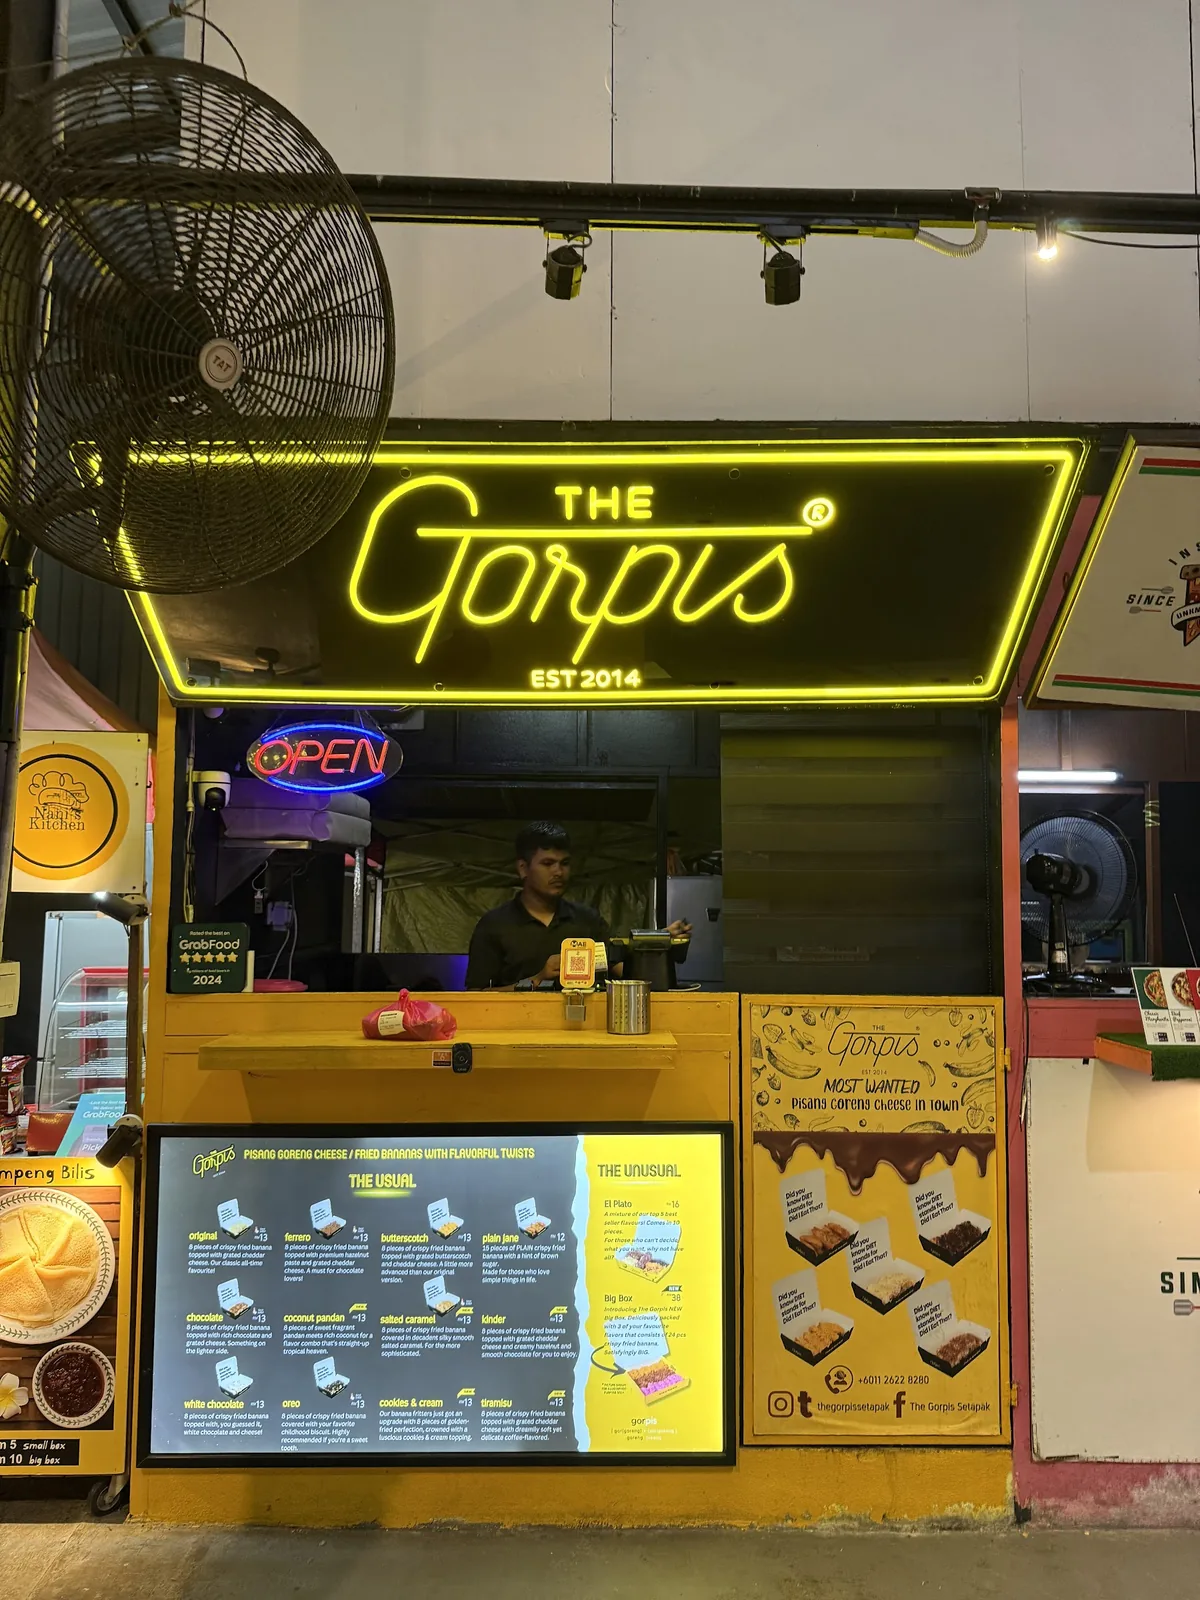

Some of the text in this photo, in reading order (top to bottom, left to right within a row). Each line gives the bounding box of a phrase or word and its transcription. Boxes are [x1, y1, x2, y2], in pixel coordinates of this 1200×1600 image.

[212, 354, 232, 373] TAT
[554, 485, 654, 520] THE
[348, 475, 812, 664] Gorpis
[1126, 594, 1176, 607] SINCE
[531, 669, 641, 689] EST 2014
[254, 738, 389, 775] OPEN
[34, 806, 82, 820] Nani's
[29, 817, 85, 831] Kitchen
[179, 939, 240, 950] GrabFood
[193, 975, 222, 985] 2024
[827, 1020, 920, 1067] Gorpis
[824, 1078, 920, 1094] MOST WANTED
[244, 1149, 275, 1160] PISANG
[278, 1149, 312, 1160] GORENG
[314, 1149, 347, 1160] CHEESE
[355, 1148, 379, 1159] FRIED
[382, 1148, 423, 1159] BANANAS
[424, 1148, 448, 1159] WITH
[449, 1148, 499, 1159] FLAVORFUL
[500, 1147, 535, 1159] TWISTS
[192, 1144, 236, 1178] Gorpis
[61, 1163, 95, 1180] Bilis
[597, 1164, 681, 1177] THE UNUSUAL
[348, 1173, 416, 1188] THE USUAL
[785, 1188, 806, 1199] Did you
[787, 1192, 813, 1207] know DIET
[915, 1190, 935, 1203] Did you
[604, 1200, 611, 1208] El
[613, 1200, 632, 1208] Plato
[917, 1193, 943, 1210] know DIET
[788, 1203, 806, 1215] stands
[789, 1213, 798, 1222] Did
[801, 1209, 810, 1217] Eat
[809, 1202, 824, 1213] That?
[919, 1205, 936, 1218] stands
[920, 1215, 930, 1225] Did
[932, 1210, 941, 1219] Eat
[940, 1203, 954, 1214] That?
[188, 1231, 218, 1242] original
[284, 1232, 311, 1242] ferrero
[381, 1233, 429, 1243] butterscotch
[482, 1234, 501, 1243] plain
[502, 1234, 519, 1243] jane
[604, 1294, 616, 1303] Big
[619, 1294, 632, 1302] Box
[186, 1313, 224, 1322] chocolate
[284, 1314, 315, 1322] coconut
[316, 1314, 345, 1324] pandan
[380, 1314, 404, 1324] salted
[405, 1315, 436, 1324] caramel
[481, 1314, 506, 1324] kinder
[858, 1375, 930, 1385] +6011 2622 8280
[184, 1400, 205, 1409] white
[207, 1400, 244, 1409] chocolate
[282, 1400, 300, 1408] oreo
[379, 1398, 409, 1408] cookies
[411, 1398, 417, 1407] &
[419, 1399, 443, 1408] cream
[481, 1398, 512, 1408] tiramisu
[817, 1402, 890, 1413] thegorpissetapak
[910, 1402, 926, 1411] The
[928, 1402, 955, 1413] Gorpis
[957, 1402, 991, 1413] Setapak
[10, 1440, 17, 1450] 5
[23, 1440, 48, 1450] small
[50, 1440, 66, 1450] box
[10, 1454, 23, 1464] 10
[29, 1455, 42, 1467] big
[44, 1455, 60, 1464] box
